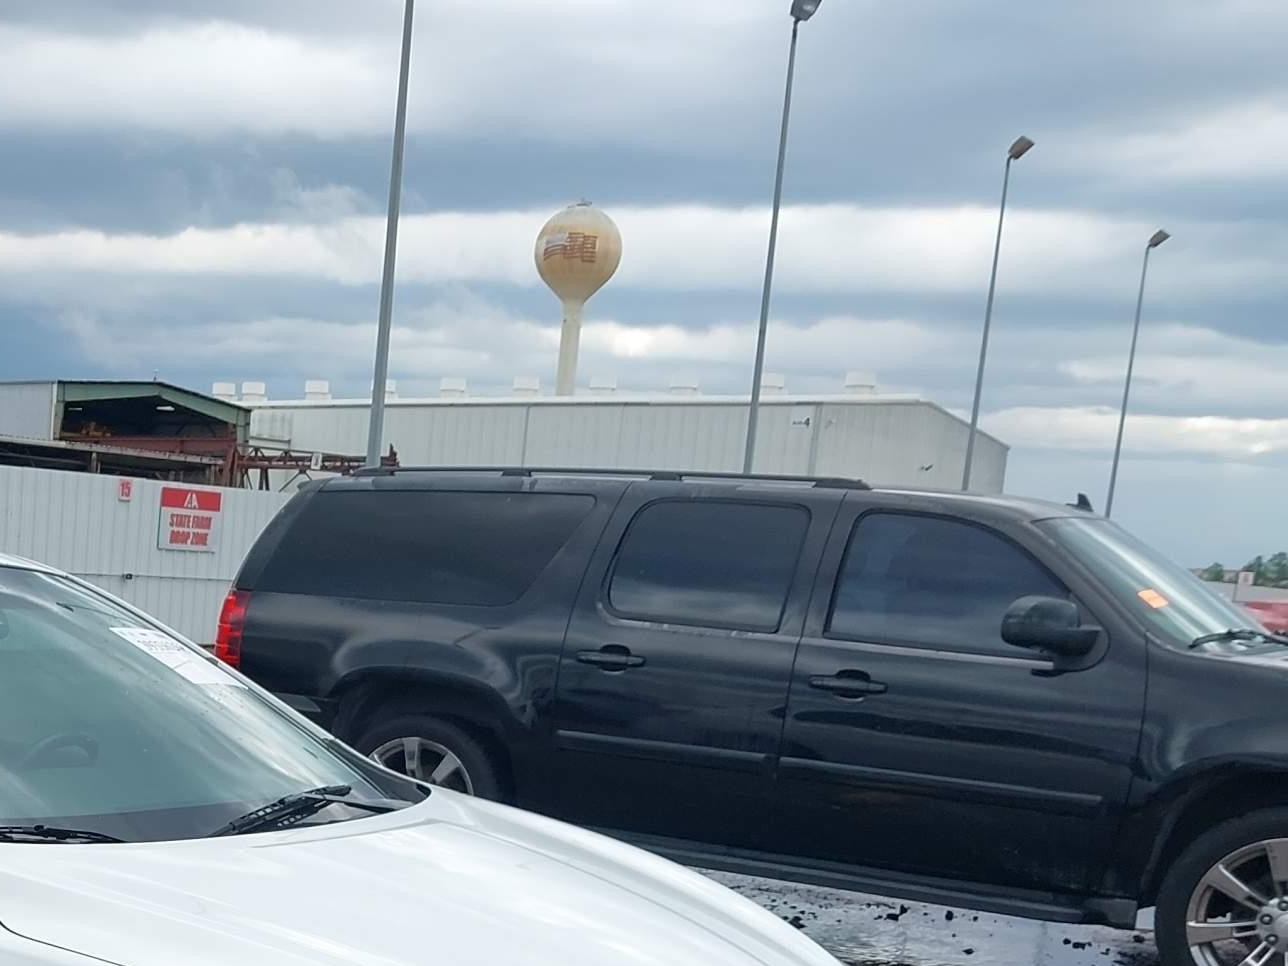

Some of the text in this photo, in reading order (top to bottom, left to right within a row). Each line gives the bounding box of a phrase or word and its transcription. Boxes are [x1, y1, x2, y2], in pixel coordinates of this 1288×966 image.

[120, 482, 131, 498] 15
[169, 513, 211, 529] STATE FARM
[169, 530, 208, 545] DROP ZONE
